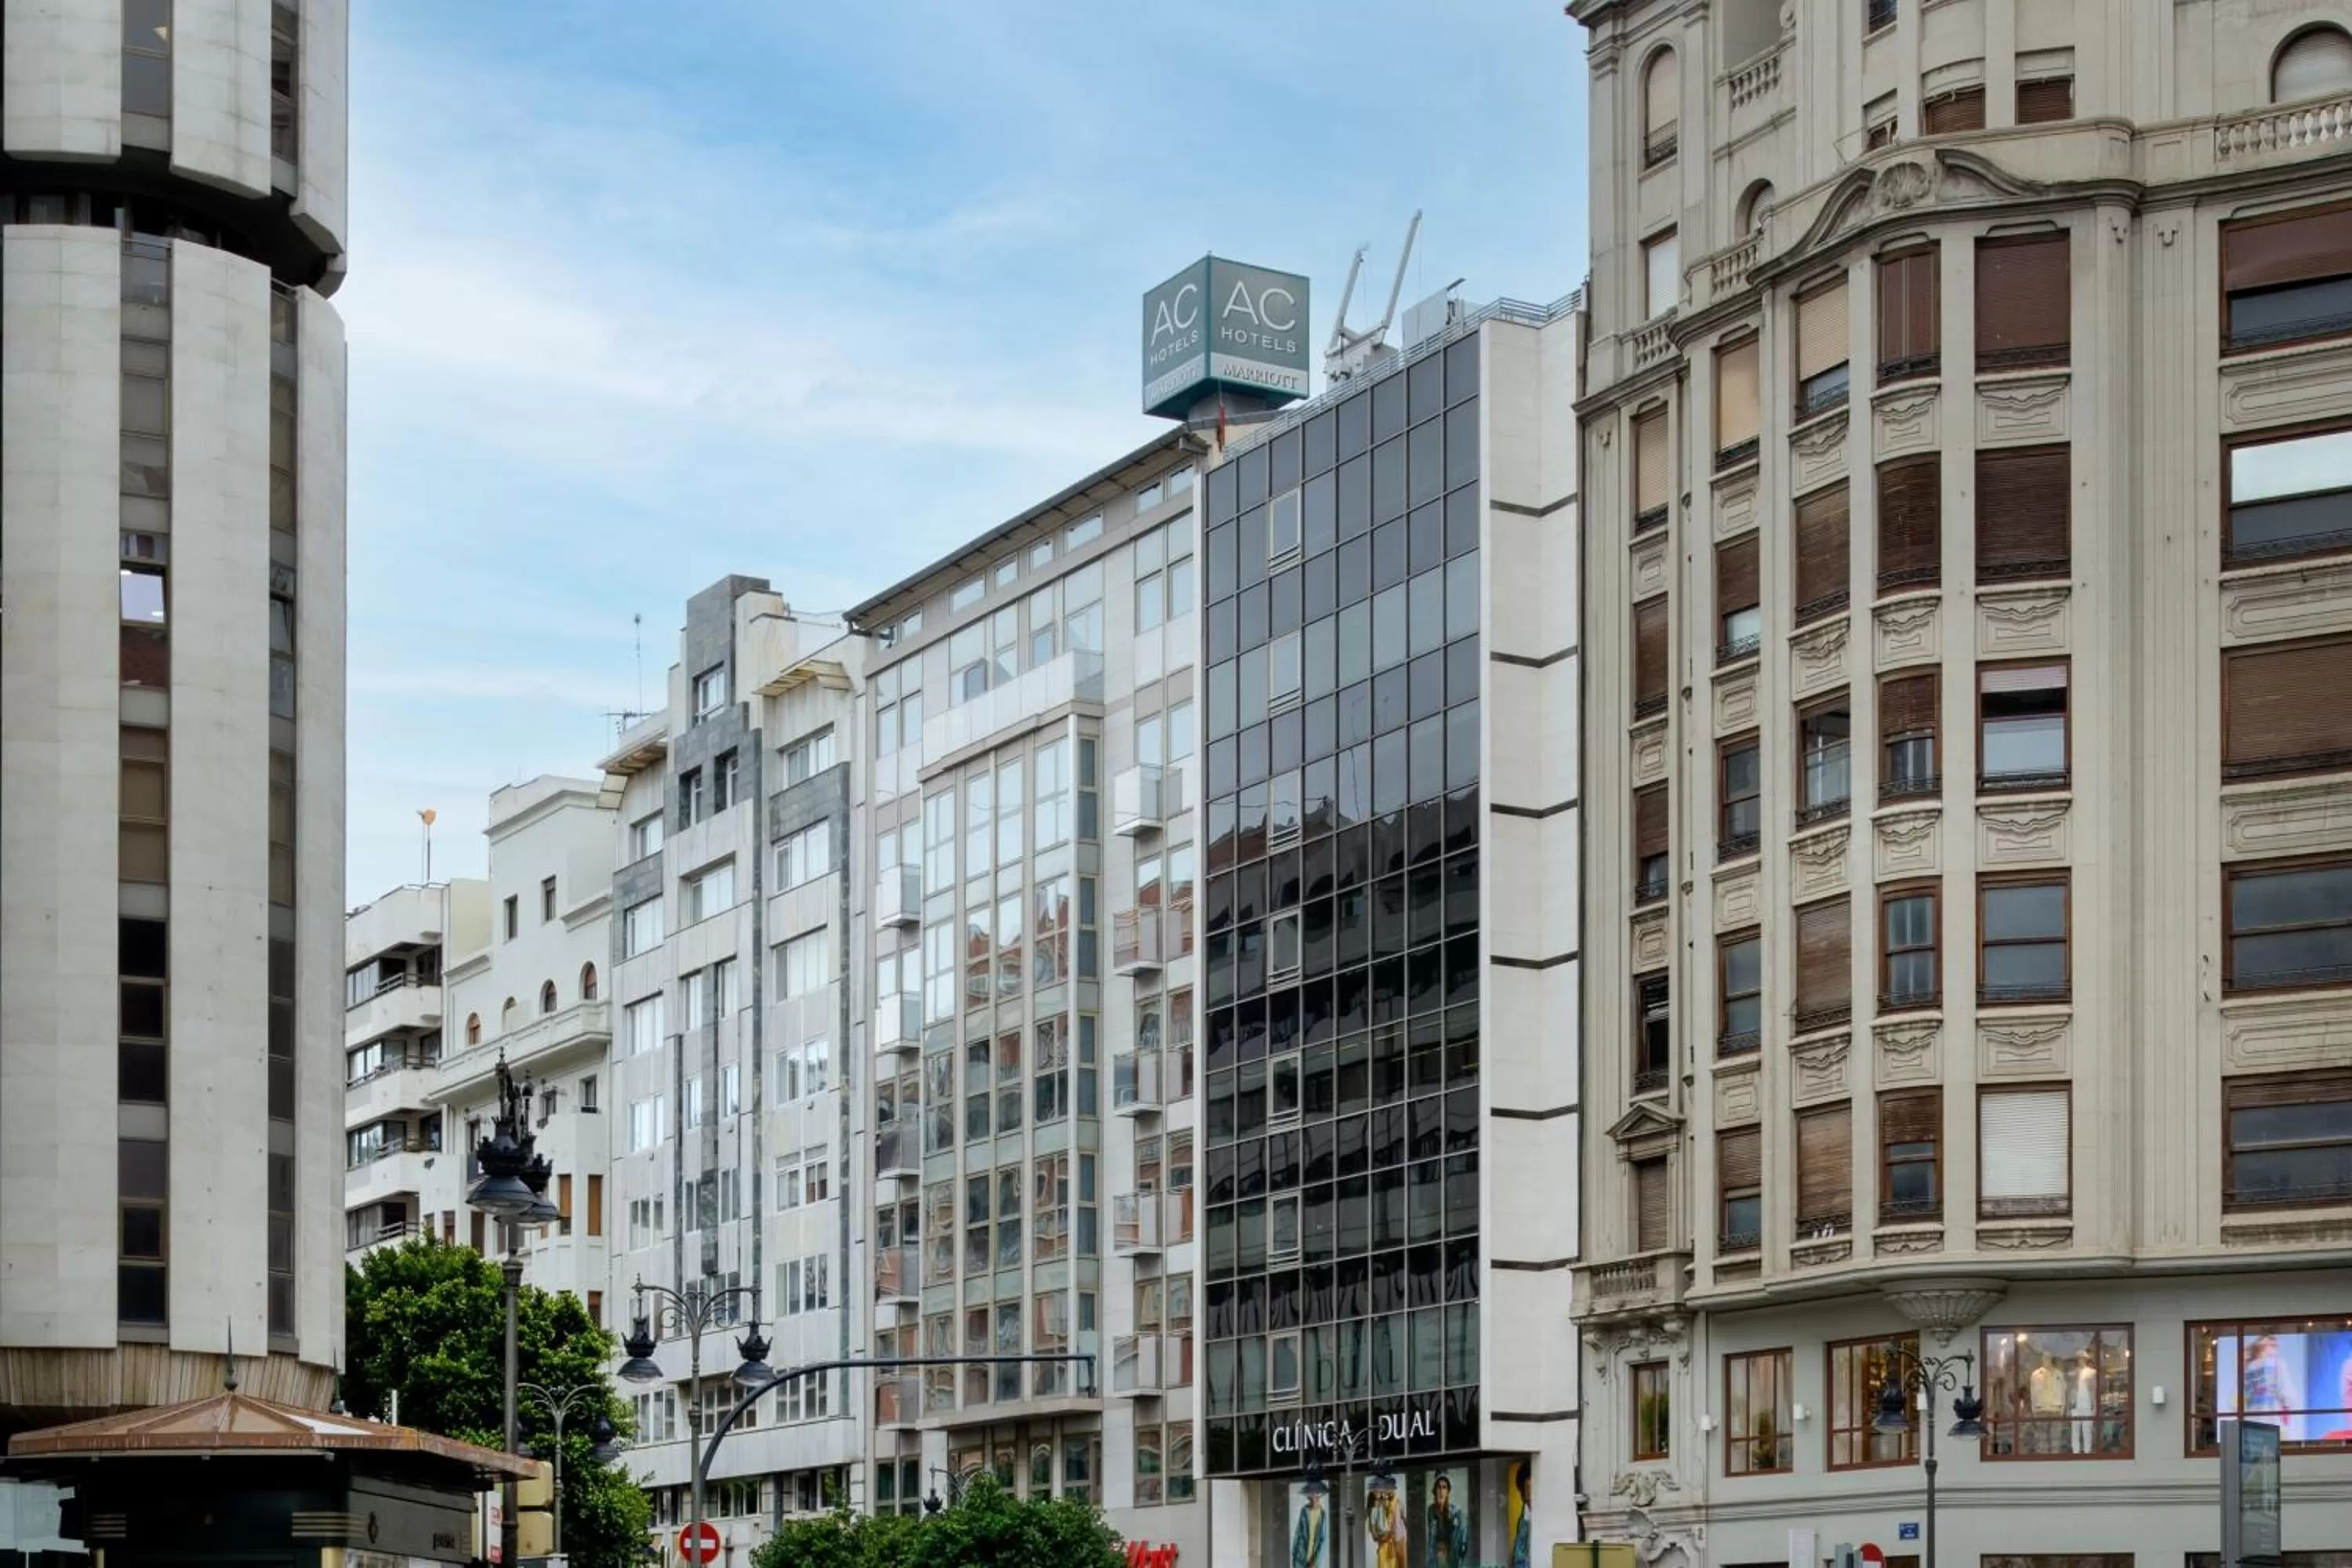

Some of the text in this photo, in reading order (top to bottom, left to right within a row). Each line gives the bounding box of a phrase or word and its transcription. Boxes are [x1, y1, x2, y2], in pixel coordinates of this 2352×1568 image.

[1150, 283, 1198, 346] AC
[1222, 280, 1295, 331] AC
[1149, 329, 1198, 365] HOTELS
[1221, 326, 1296, 352] HOTELS
[1224, 363, 1298, 390] MARRIOTT
[1378, 1410, 1436, 1441] DUAL
